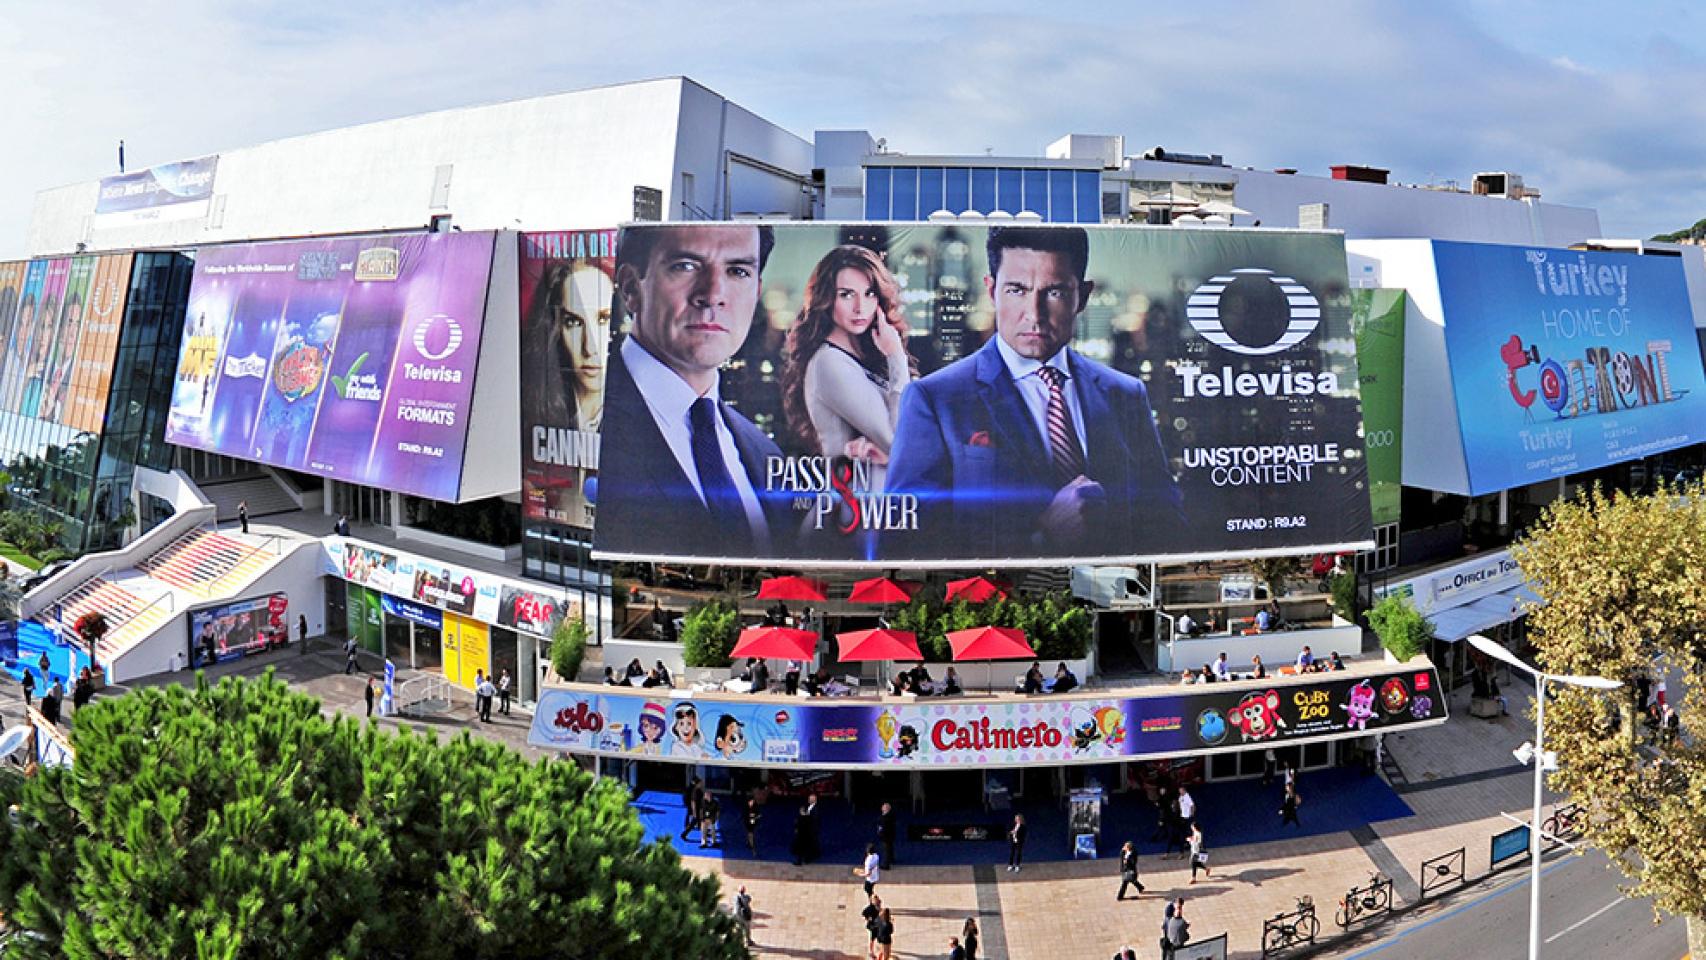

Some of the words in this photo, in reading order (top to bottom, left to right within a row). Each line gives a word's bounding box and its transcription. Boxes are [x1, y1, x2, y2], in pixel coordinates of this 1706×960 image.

[527, 233, 586, 258] NATALIA
[1526, 250, 1628, 306] Turkey
[1542, 308, 1606, 339] HOME
[1608, 307, 1632, 337] OF
[404, 363, 462, 384] Televisa
[1175, 364, 1338, 397] Televisa
[345, 384, 382, 400] friends
[398, 406, 455, 427] FORMATS
[1518, 426, 1573, 451] Turkey
[1183, 443, 1339, 468] UNSTOPPABLE
[1211, 463, 1314, 486] CONTENT
[1226, 518, 1267, 531] STAND
[1274, 516, 1307, 528] R9.A2
[513, 596, 554, 624] FEAR
[931, 716, 1062, 751] Calimero
